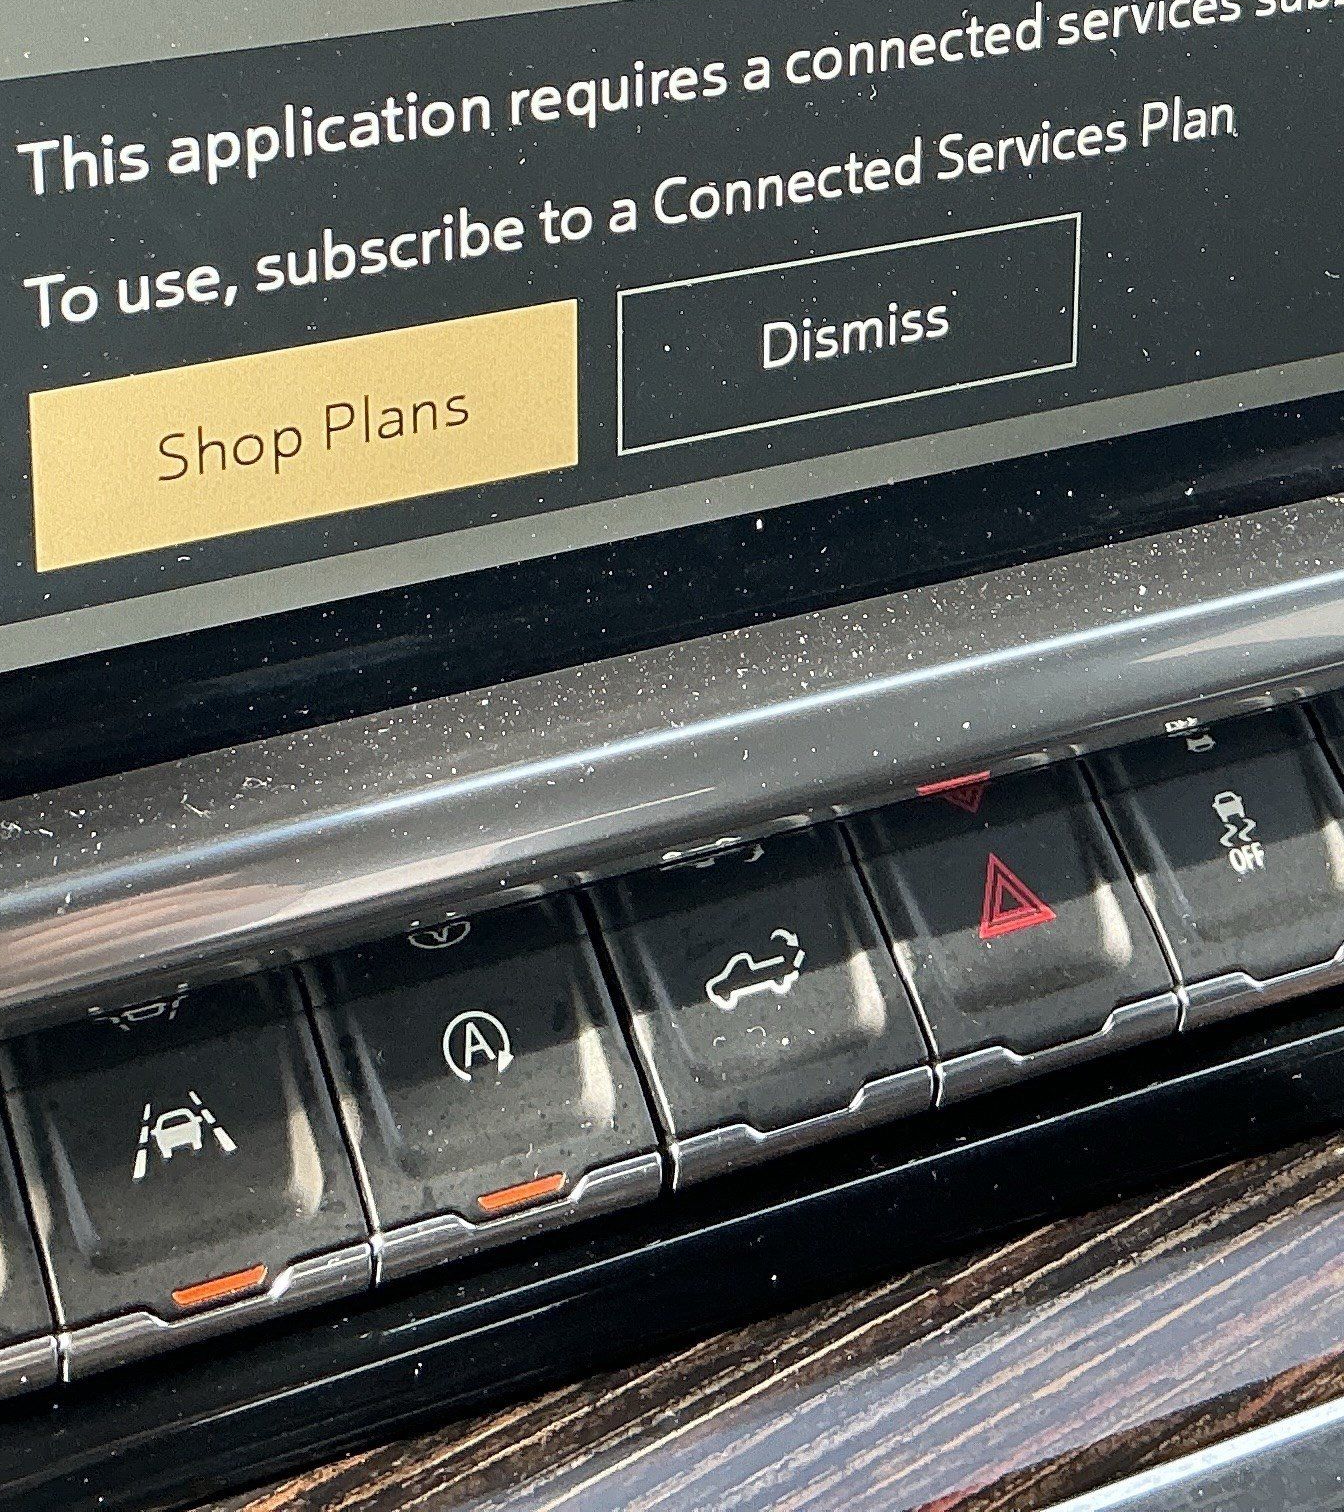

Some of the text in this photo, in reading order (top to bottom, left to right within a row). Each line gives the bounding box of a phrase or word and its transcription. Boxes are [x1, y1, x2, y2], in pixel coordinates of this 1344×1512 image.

[17, 134, 148, 195] This
[167, 92, 491, 185] application
[509, 61, 728, 129] requires
[743, 53, 772, 89] a
[786, 1, 1044, 84] connected
[23, 96, 1235, 328] To use, subscribe to a Connected Services Plan
[763, 303, 949, 369] Dismiss
[158, 393, 470, 482] Shop Plans
[1229, 842, 1265, 873] OFF
